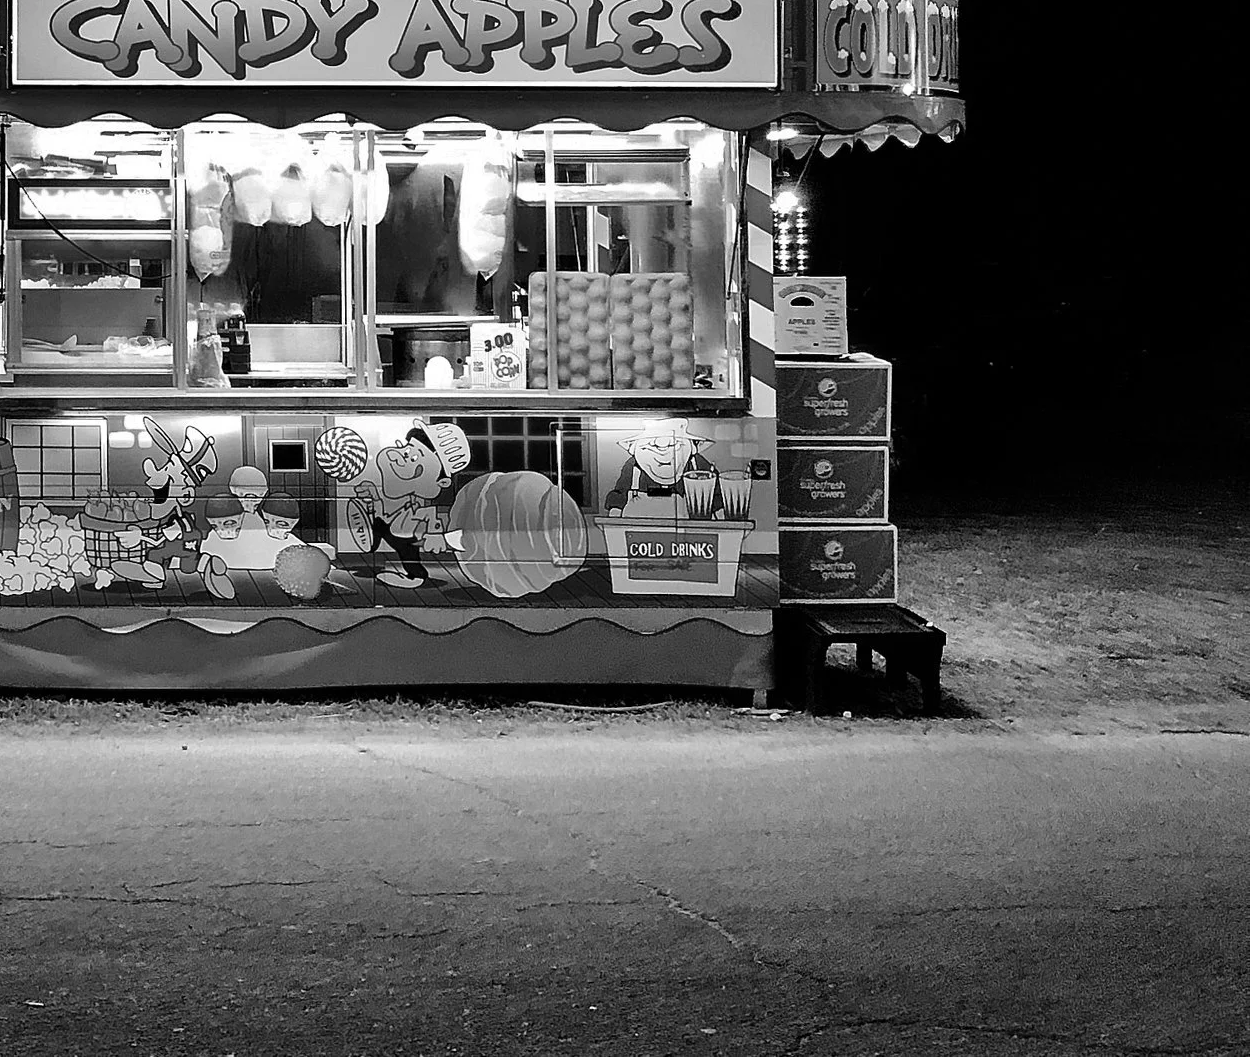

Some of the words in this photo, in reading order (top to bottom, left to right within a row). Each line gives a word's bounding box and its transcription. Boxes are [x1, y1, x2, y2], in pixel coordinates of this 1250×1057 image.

[484, 332, 513, 352] 3.00
[630, 542, 664, 557] COLD
[671, 542, 714, 559] DRINKS
